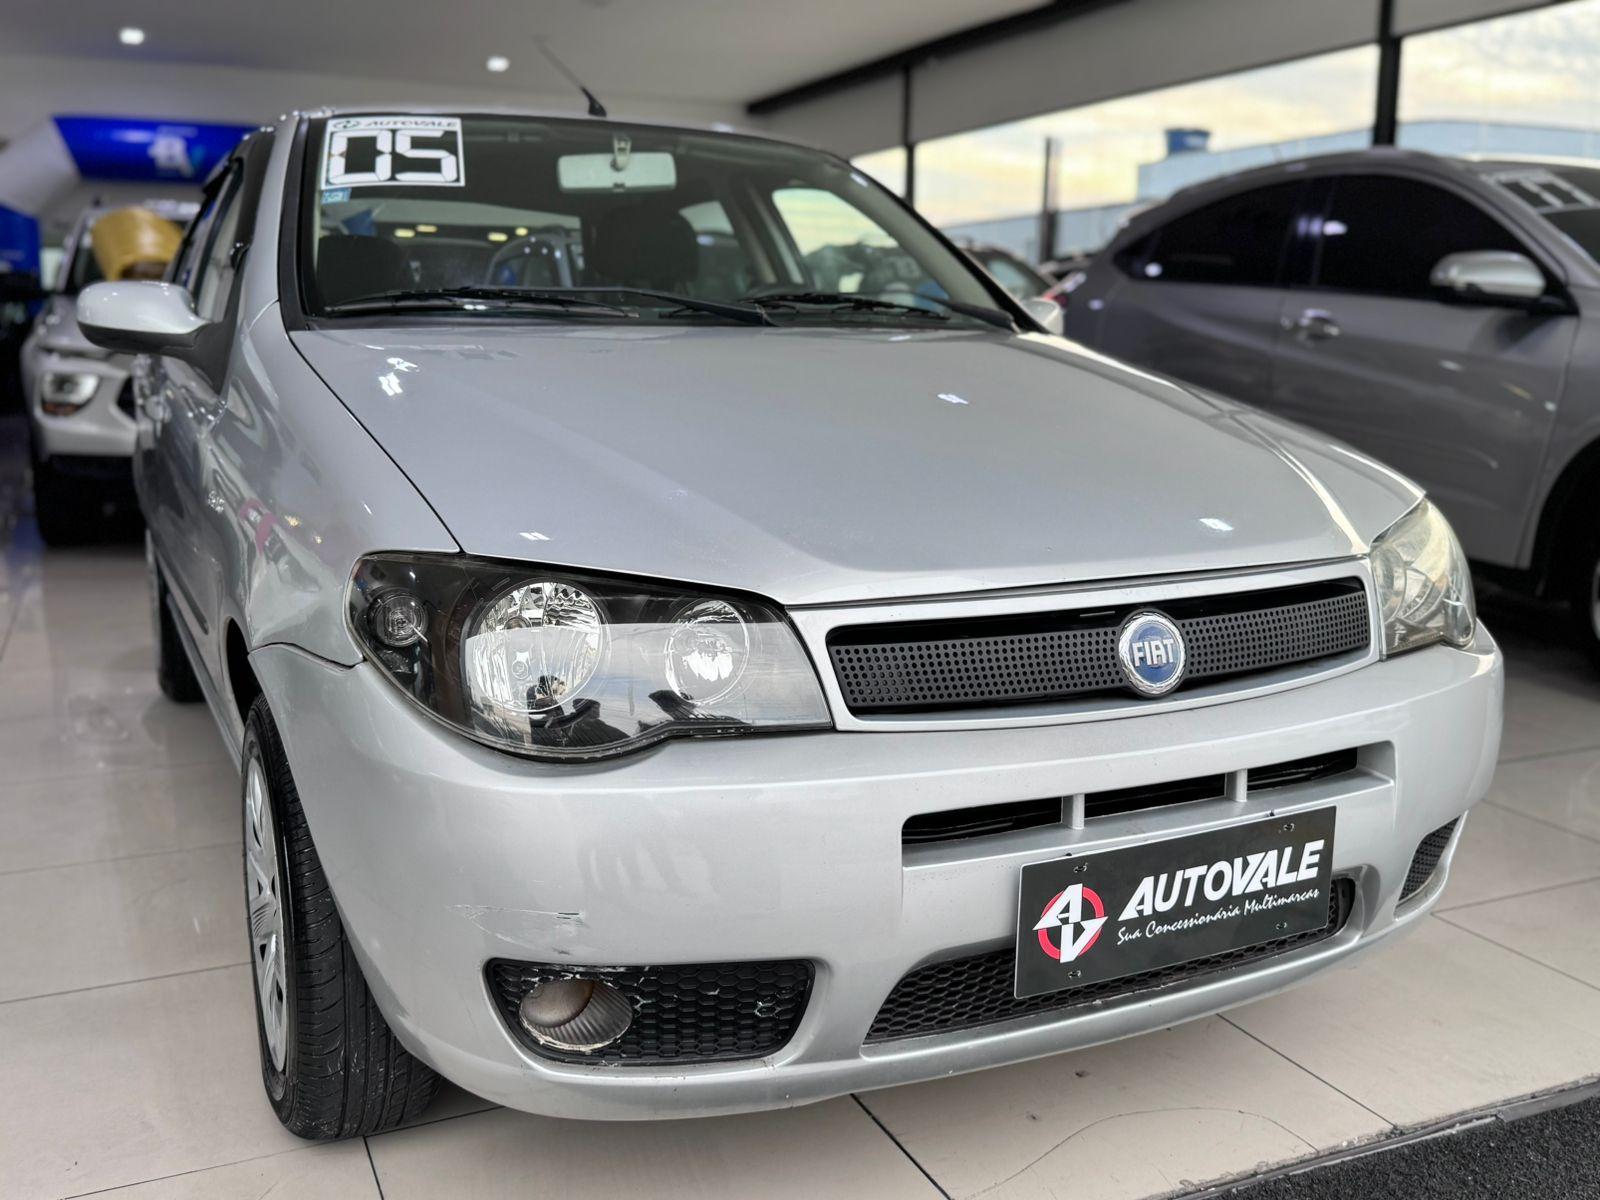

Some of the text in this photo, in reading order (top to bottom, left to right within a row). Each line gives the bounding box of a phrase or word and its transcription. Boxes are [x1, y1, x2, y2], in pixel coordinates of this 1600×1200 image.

[364, 119, 458, 129] AUTOVALE
[328, 129, 458, 185] 05
[1132, 638, 1174, 667] FIAT
[1117, 839, 1325, 922] AUTOVALE
[1116, 887, 1320, 946] Sua Concessionária Multimarcas
